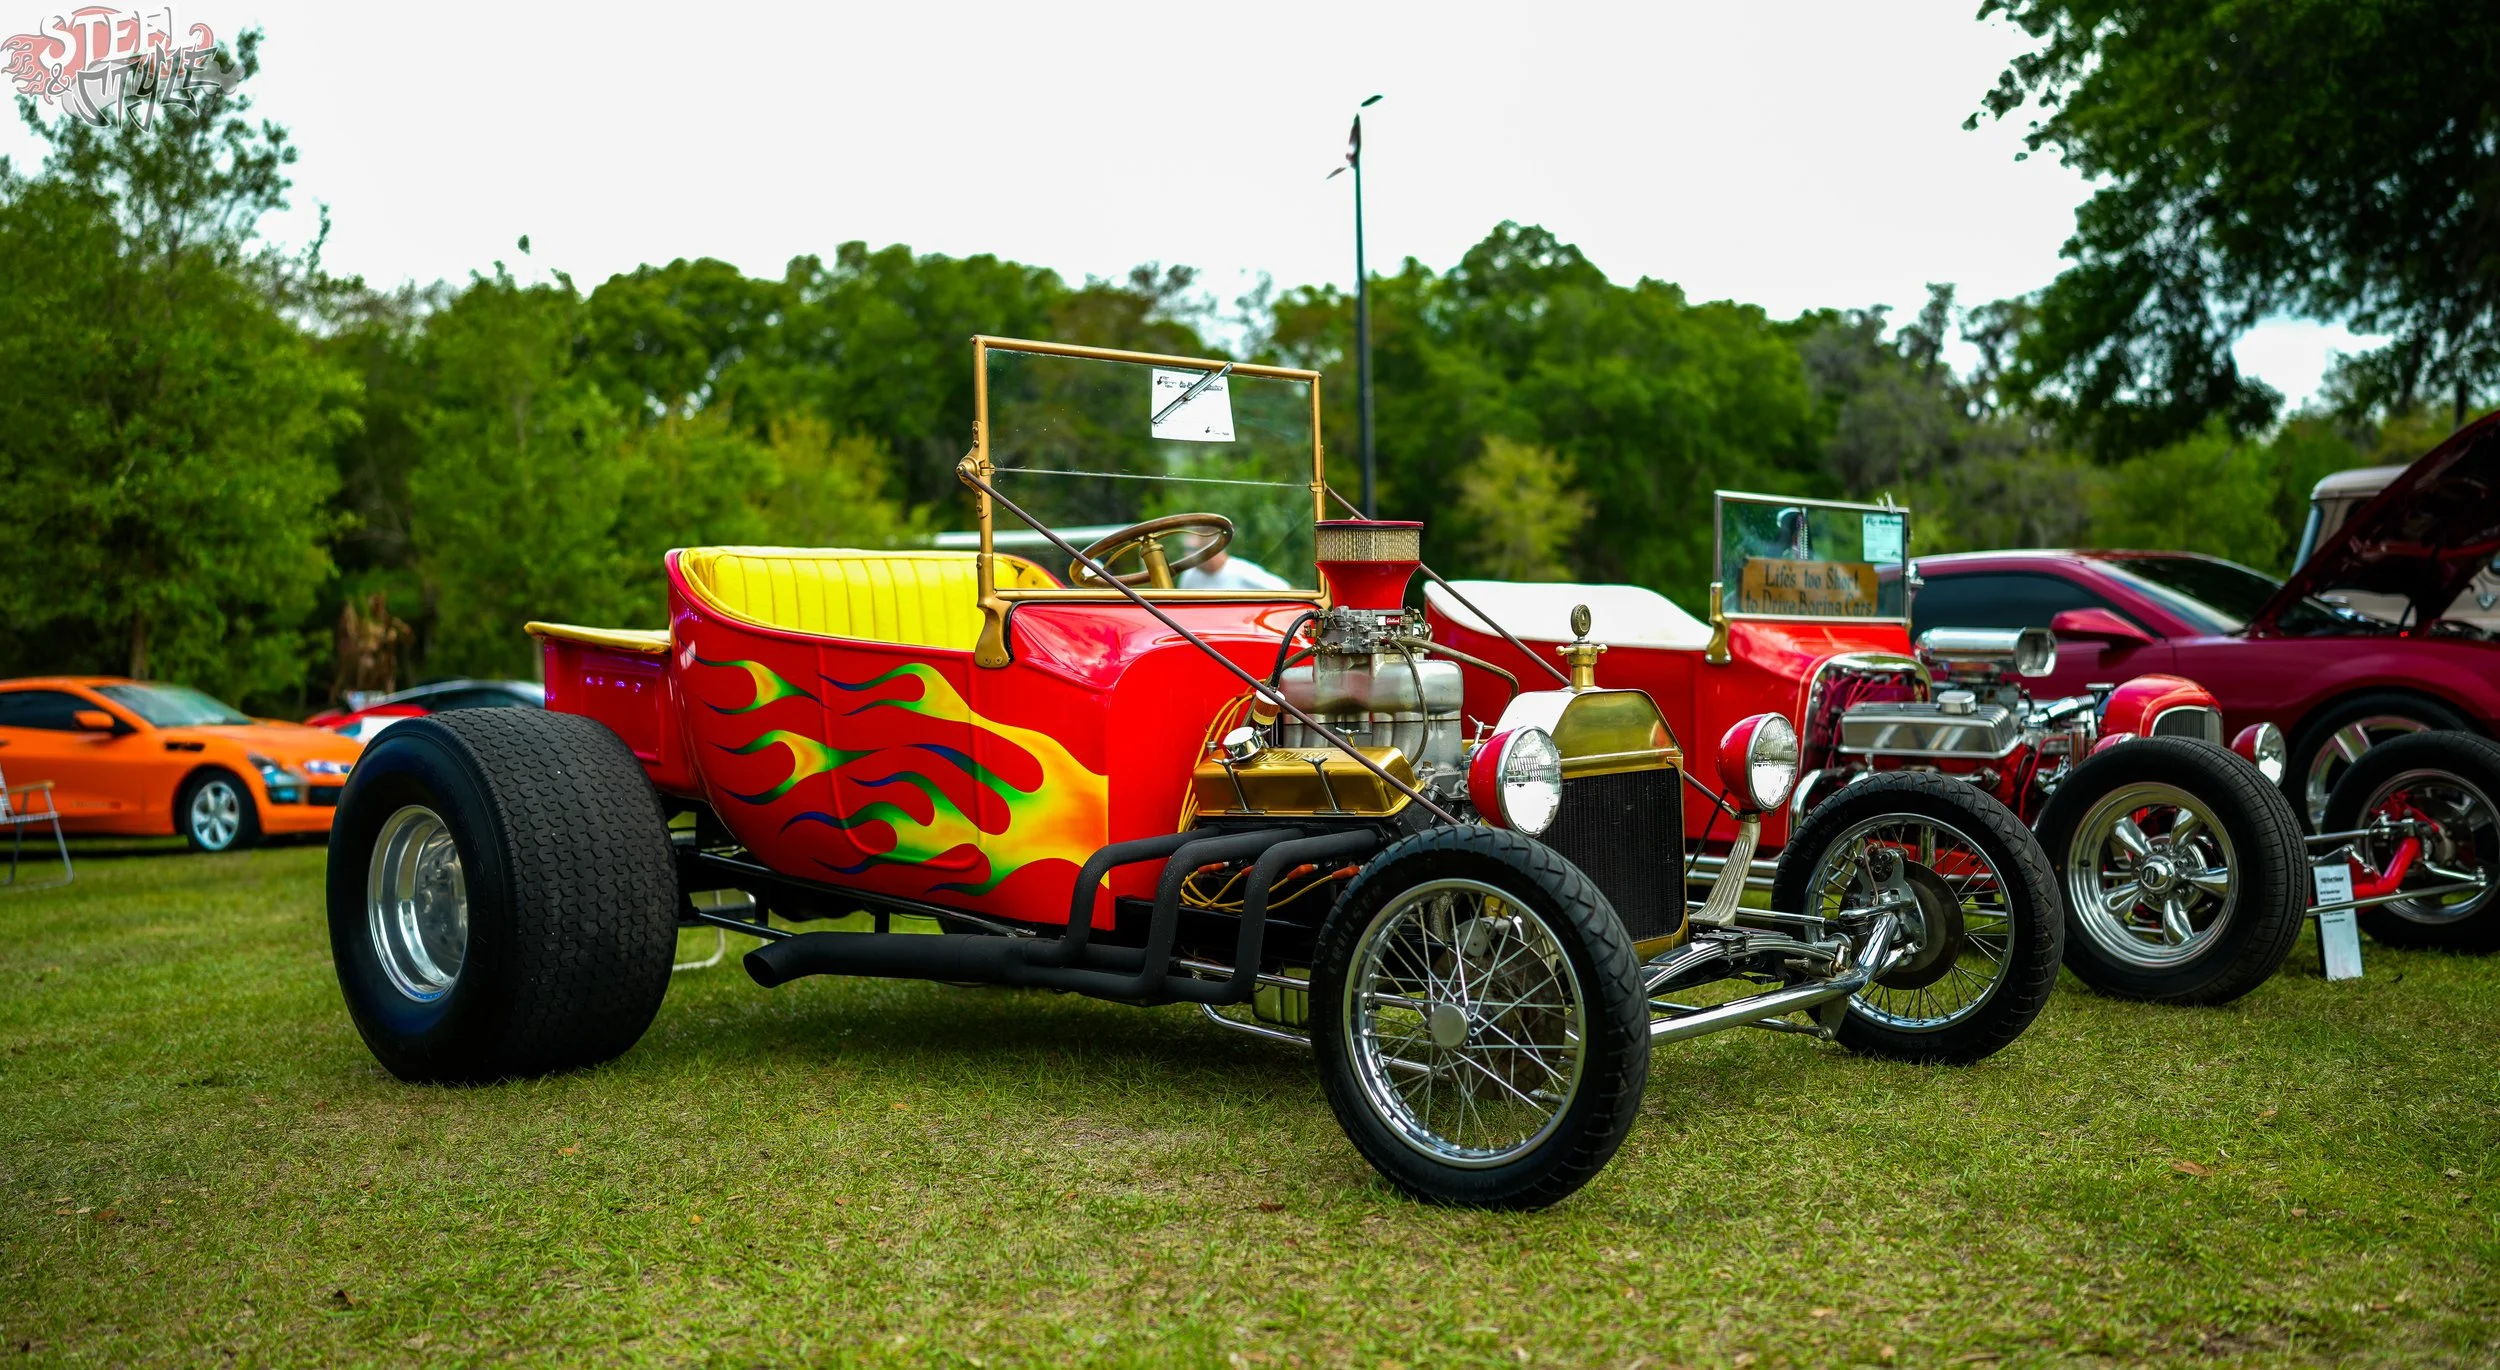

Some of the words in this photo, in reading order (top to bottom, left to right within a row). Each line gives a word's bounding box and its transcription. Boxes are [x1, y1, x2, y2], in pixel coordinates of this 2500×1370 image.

[1765, 564, 1796, 588] Life's
[1804, 568, 1822, 589] too
[1826, 565, 1858, 590] Short
[1746, 589, 1759, 613] to
[1763, 588, 1796, 615] Drive
[1798, 590, 1843, 617] Boring
[1845, 592, 1873, 617] Cars
